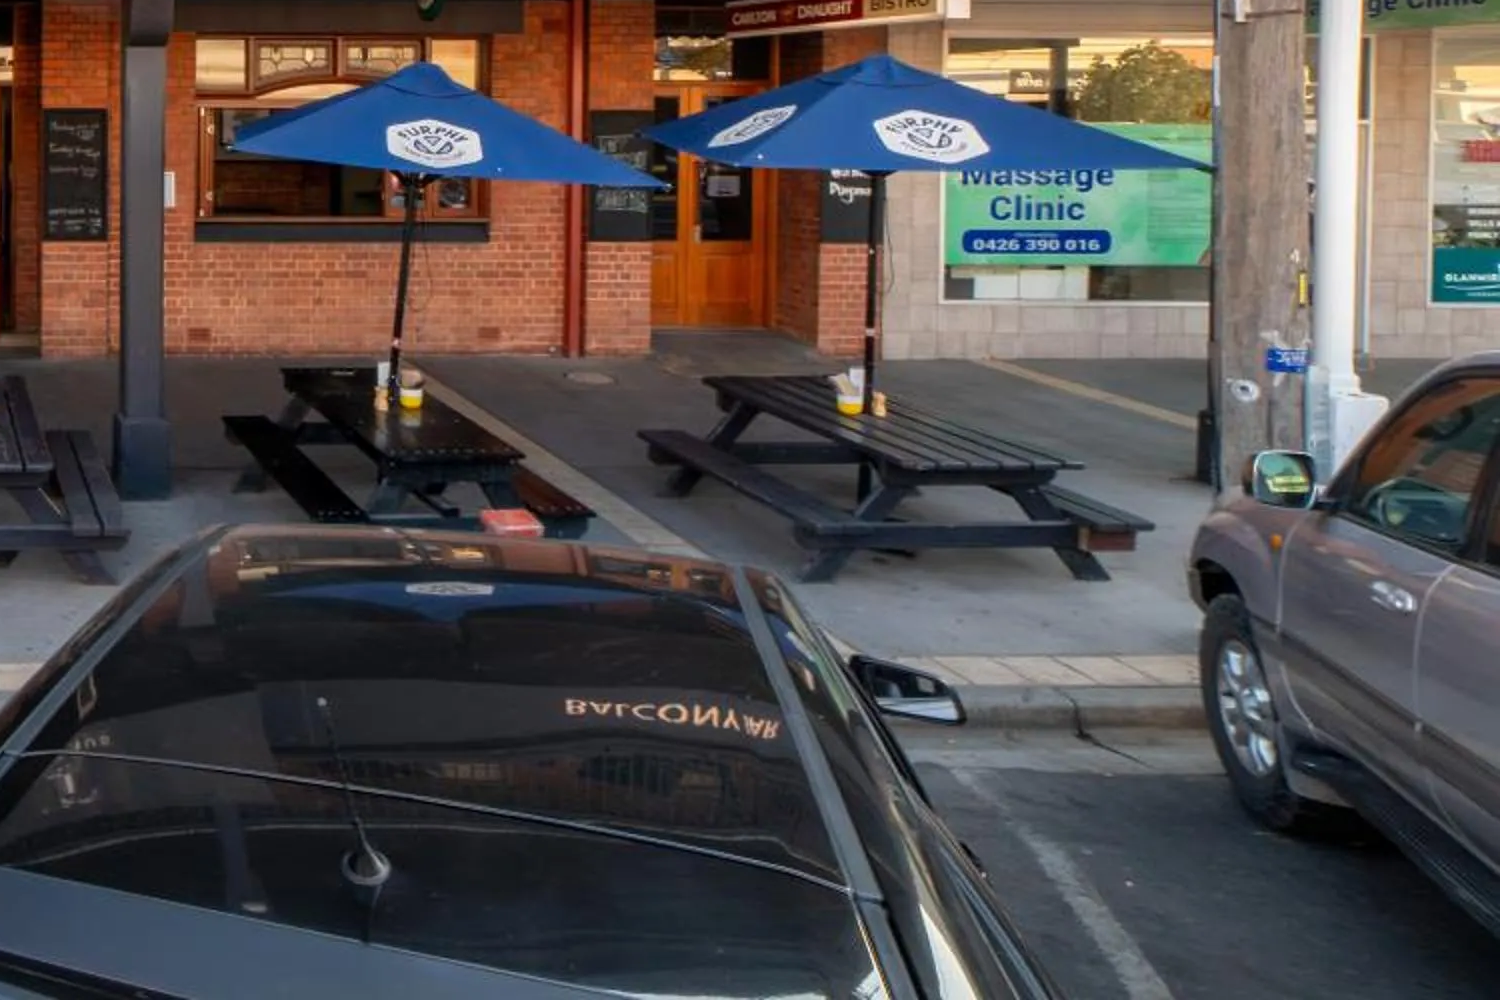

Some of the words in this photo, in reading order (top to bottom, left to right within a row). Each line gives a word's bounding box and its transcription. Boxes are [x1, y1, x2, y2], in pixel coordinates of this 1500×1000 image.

[797, 0, 853, 20] DRAUGHT
[961, 168, 1115, 193] Massage
[990, 195, 1086, 222] Clinic
[972, 238, 1020, 251] 0426
[1025, 238, 1061, 251] 390
[1064, 238, 1100, 251] 016
